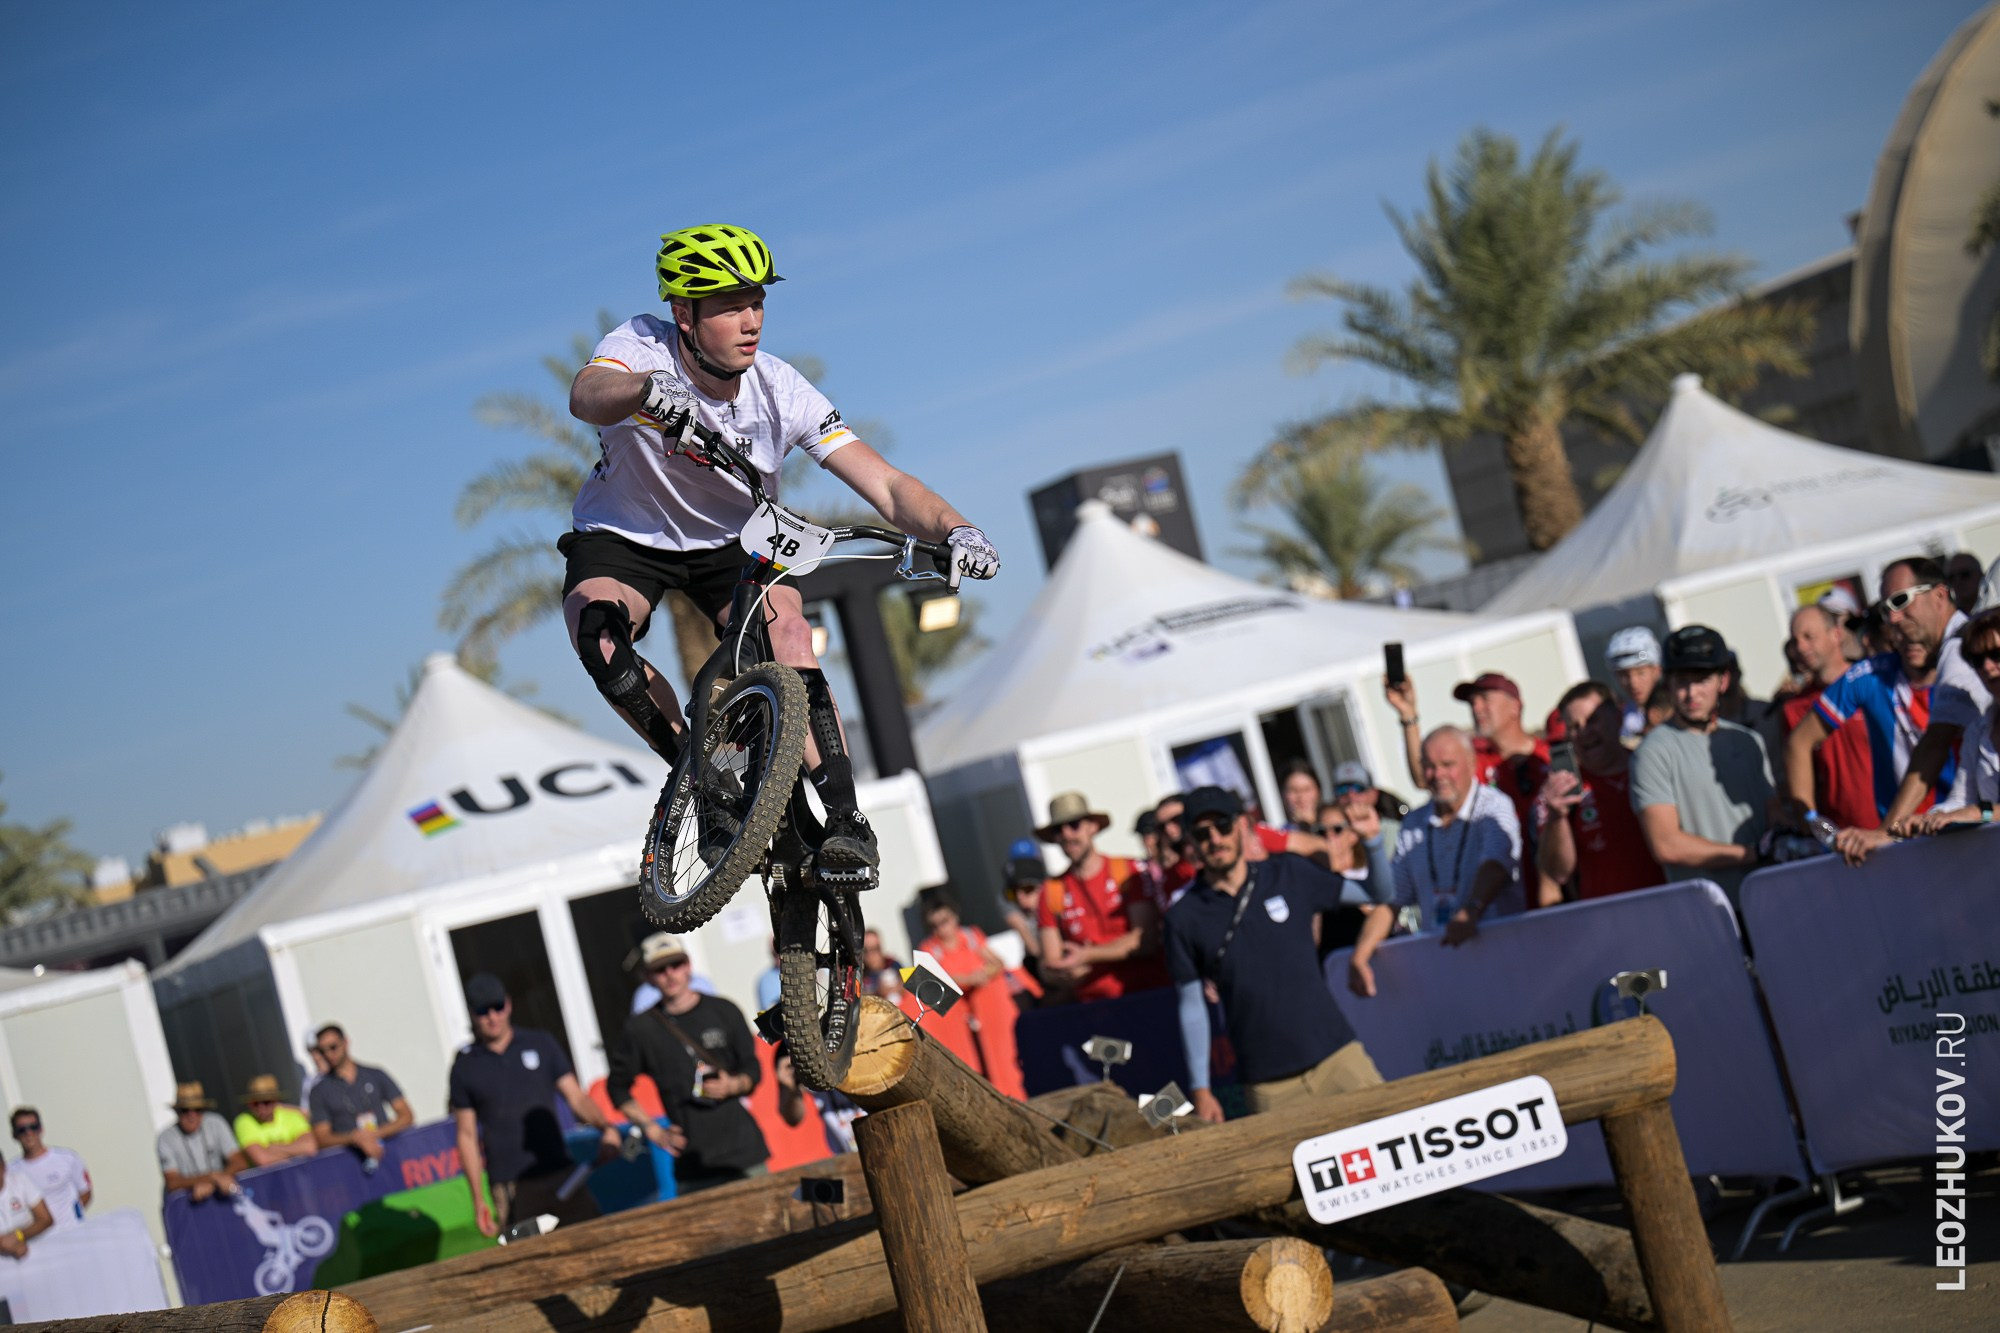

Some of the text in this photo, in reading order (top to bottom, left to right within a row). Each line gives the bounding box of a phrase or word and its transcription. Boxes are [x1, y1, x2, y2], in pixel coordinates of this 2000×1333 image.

[766, 532, 801, 557] 4B
[450, 761, 645, 816] UCI
[1877, 966, 1951, 1015] الرياض
[1377, 1097, 1544, 1171] TISSOT
[401, 1146, 464, 1191] RIYA
[1318, 1134, 1559, 1212] SWISS WATCHES SINCE 1853
